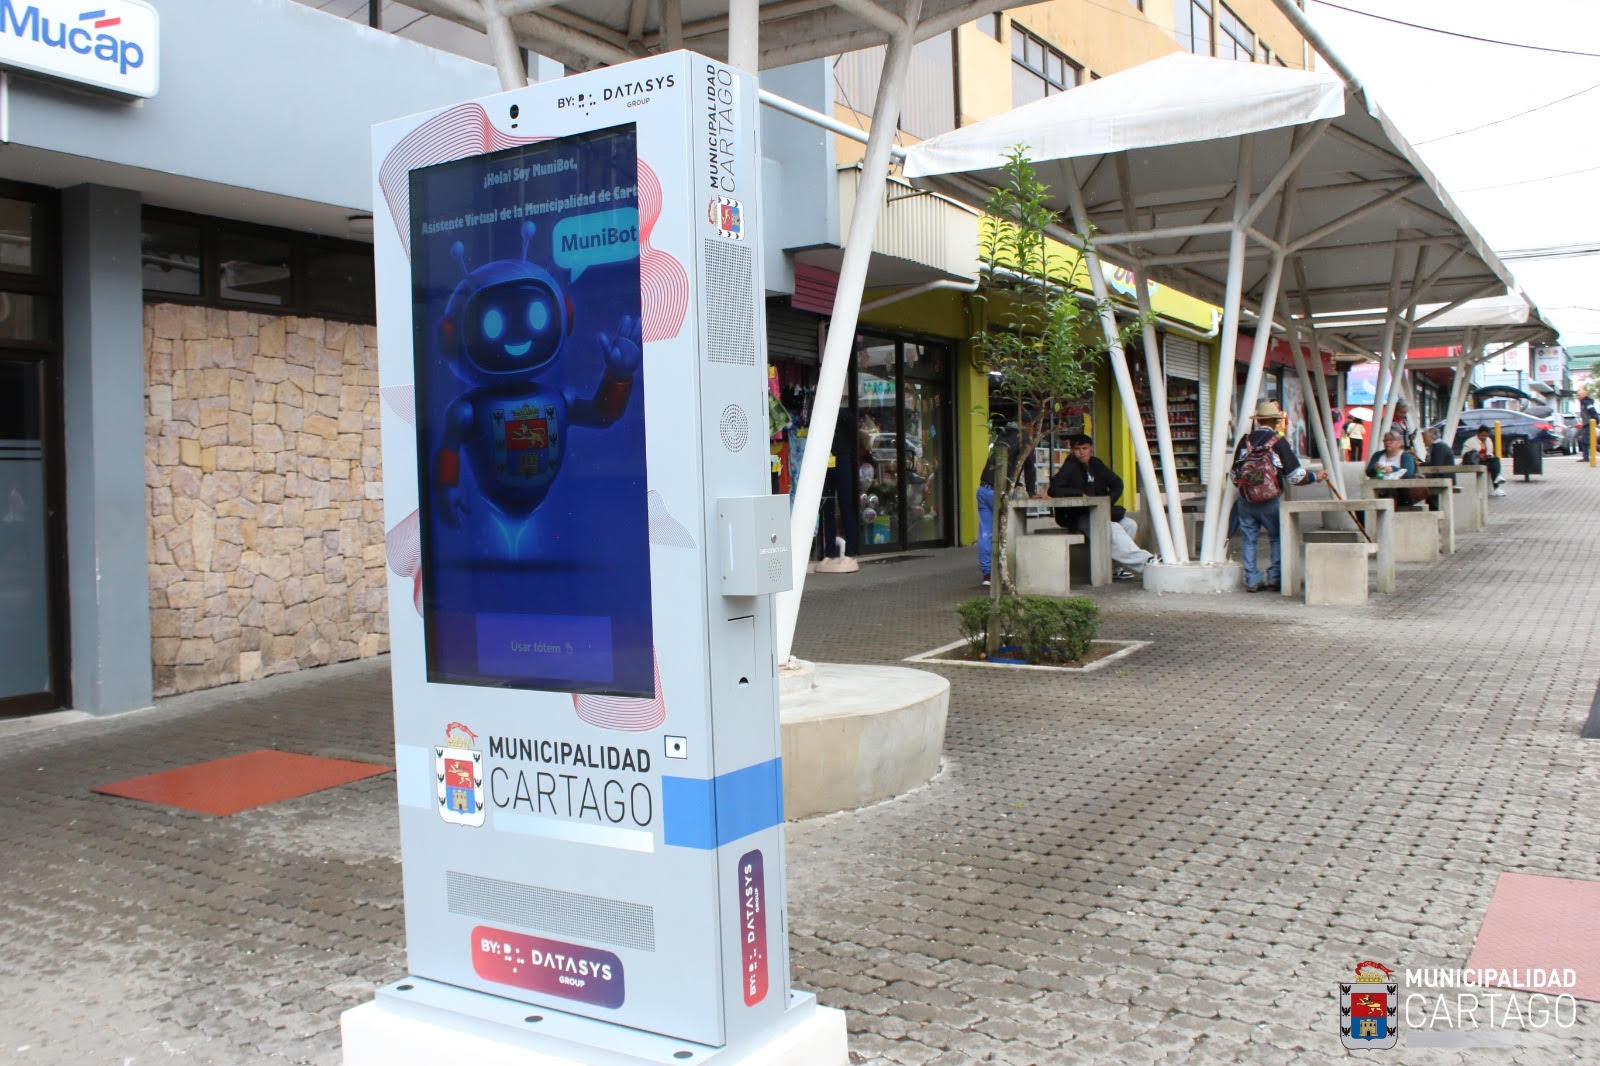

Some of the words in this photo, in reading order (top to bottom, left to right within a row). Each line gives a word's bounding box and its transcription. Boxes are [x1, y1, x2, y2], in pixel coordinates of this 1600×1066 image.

[0, 0, 144, 75] Mucap
[557, 96, 575, 109] BY:
[603, 74, 675, 101] DATASYS
[626, 97, 650, 108] GROUP
[706, 64, 719, 189] MUNICIPALIDAD
[717, 69, 735, 193] CARTAGO
[513, 167, 530, 181] Soy
[421, 217, 464, 235] Asistente
[464, 209, 498, 227] Virtual
[500, 207, 512, 221] de
[514, 204, 523, 219] la
[524, 191, 596, 217] Municipalidad
[598, 190, 611, 203] de
[561, 225, 637, 253] MuniBot
[511, 641, 532, 652] Usar
[533, 641, 561, 654] tótem
[489, 735, 651, 773] MUNICIPALIDAD
[490, 766, 652, 827] CARTAGO
[744, 863, 756, 944] DATASYS
[480, 938, 501, 955] BY:
[531, 949, 613, 981] DATASYS
[558, 975, 586, 988] GROUP
